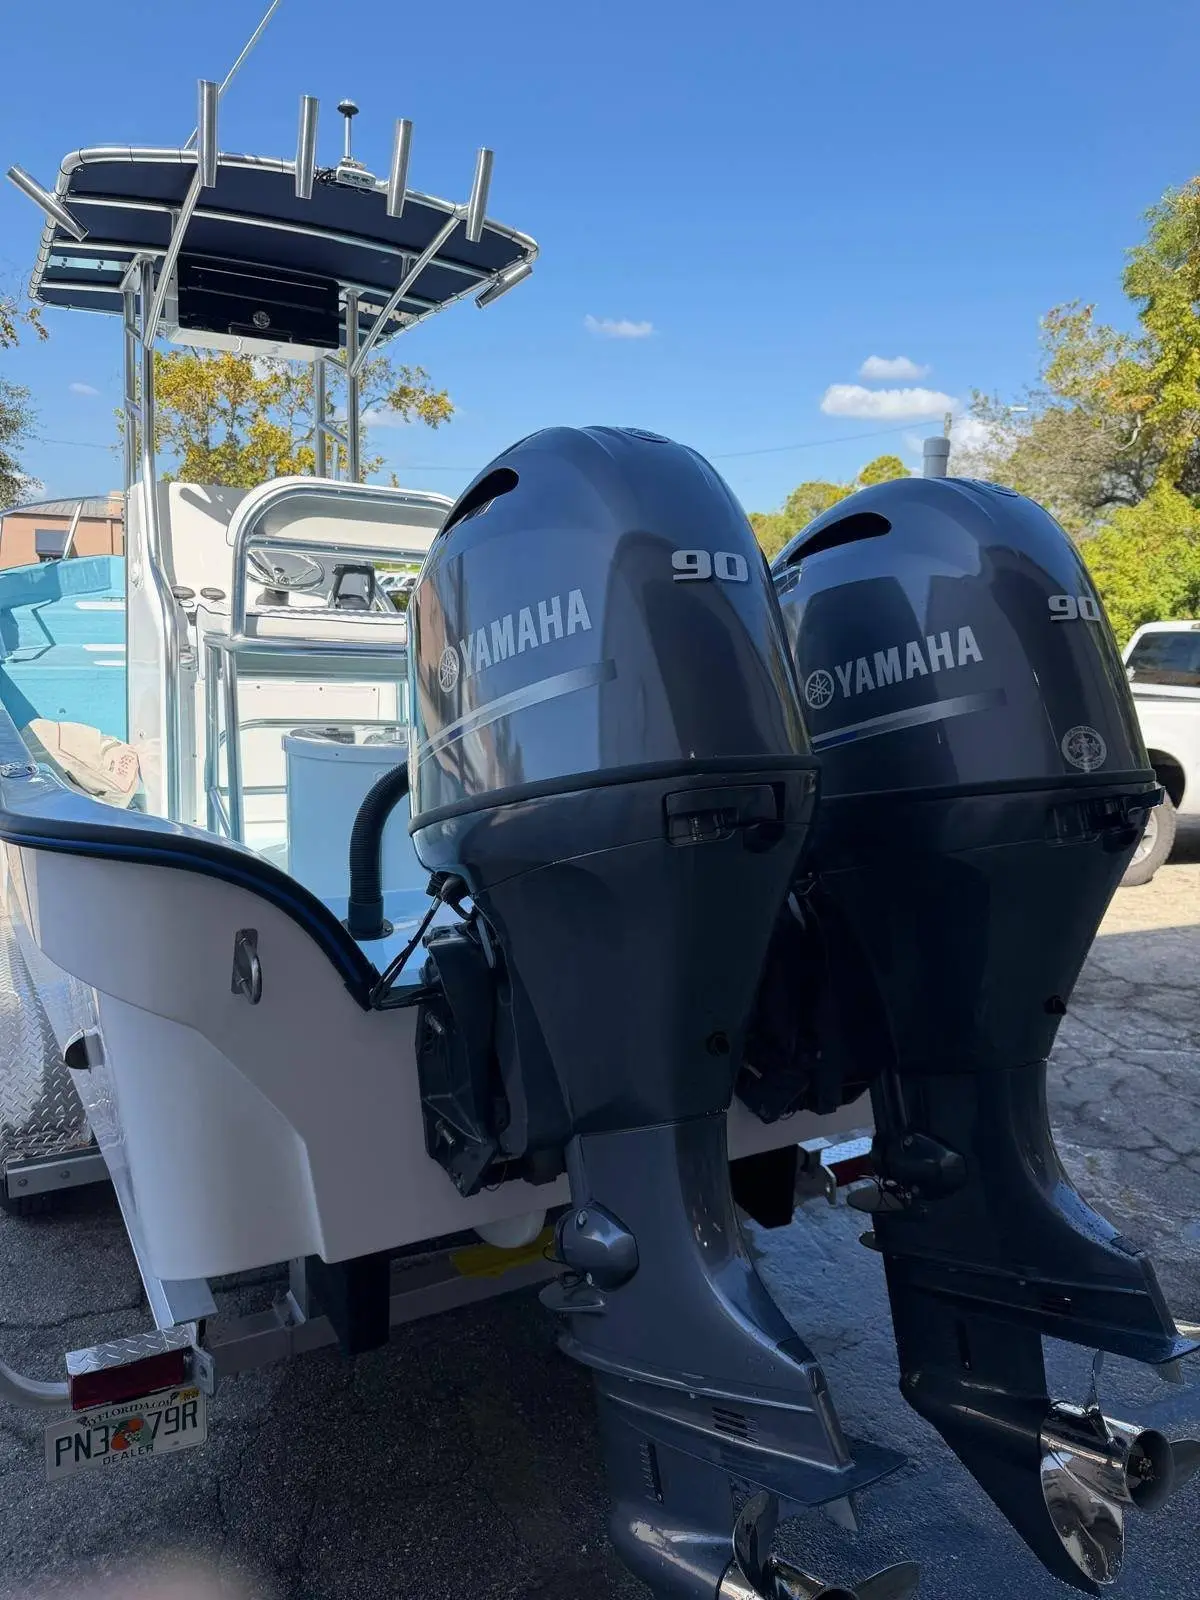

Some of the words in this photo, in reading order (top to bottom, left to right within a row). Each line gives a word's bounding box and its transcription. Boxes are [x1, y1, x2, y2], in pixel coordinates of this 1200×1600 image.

[672, 549, 749, 582] 90
[1048, 594, 1100, 621] 90
[459, 588, 593, 680] YAMAHA
[834, 625, 983, 698] YAMAHA
[147, 1400, 198, 1440] 79R
[102, 1444, 154, 1466] DEALER
